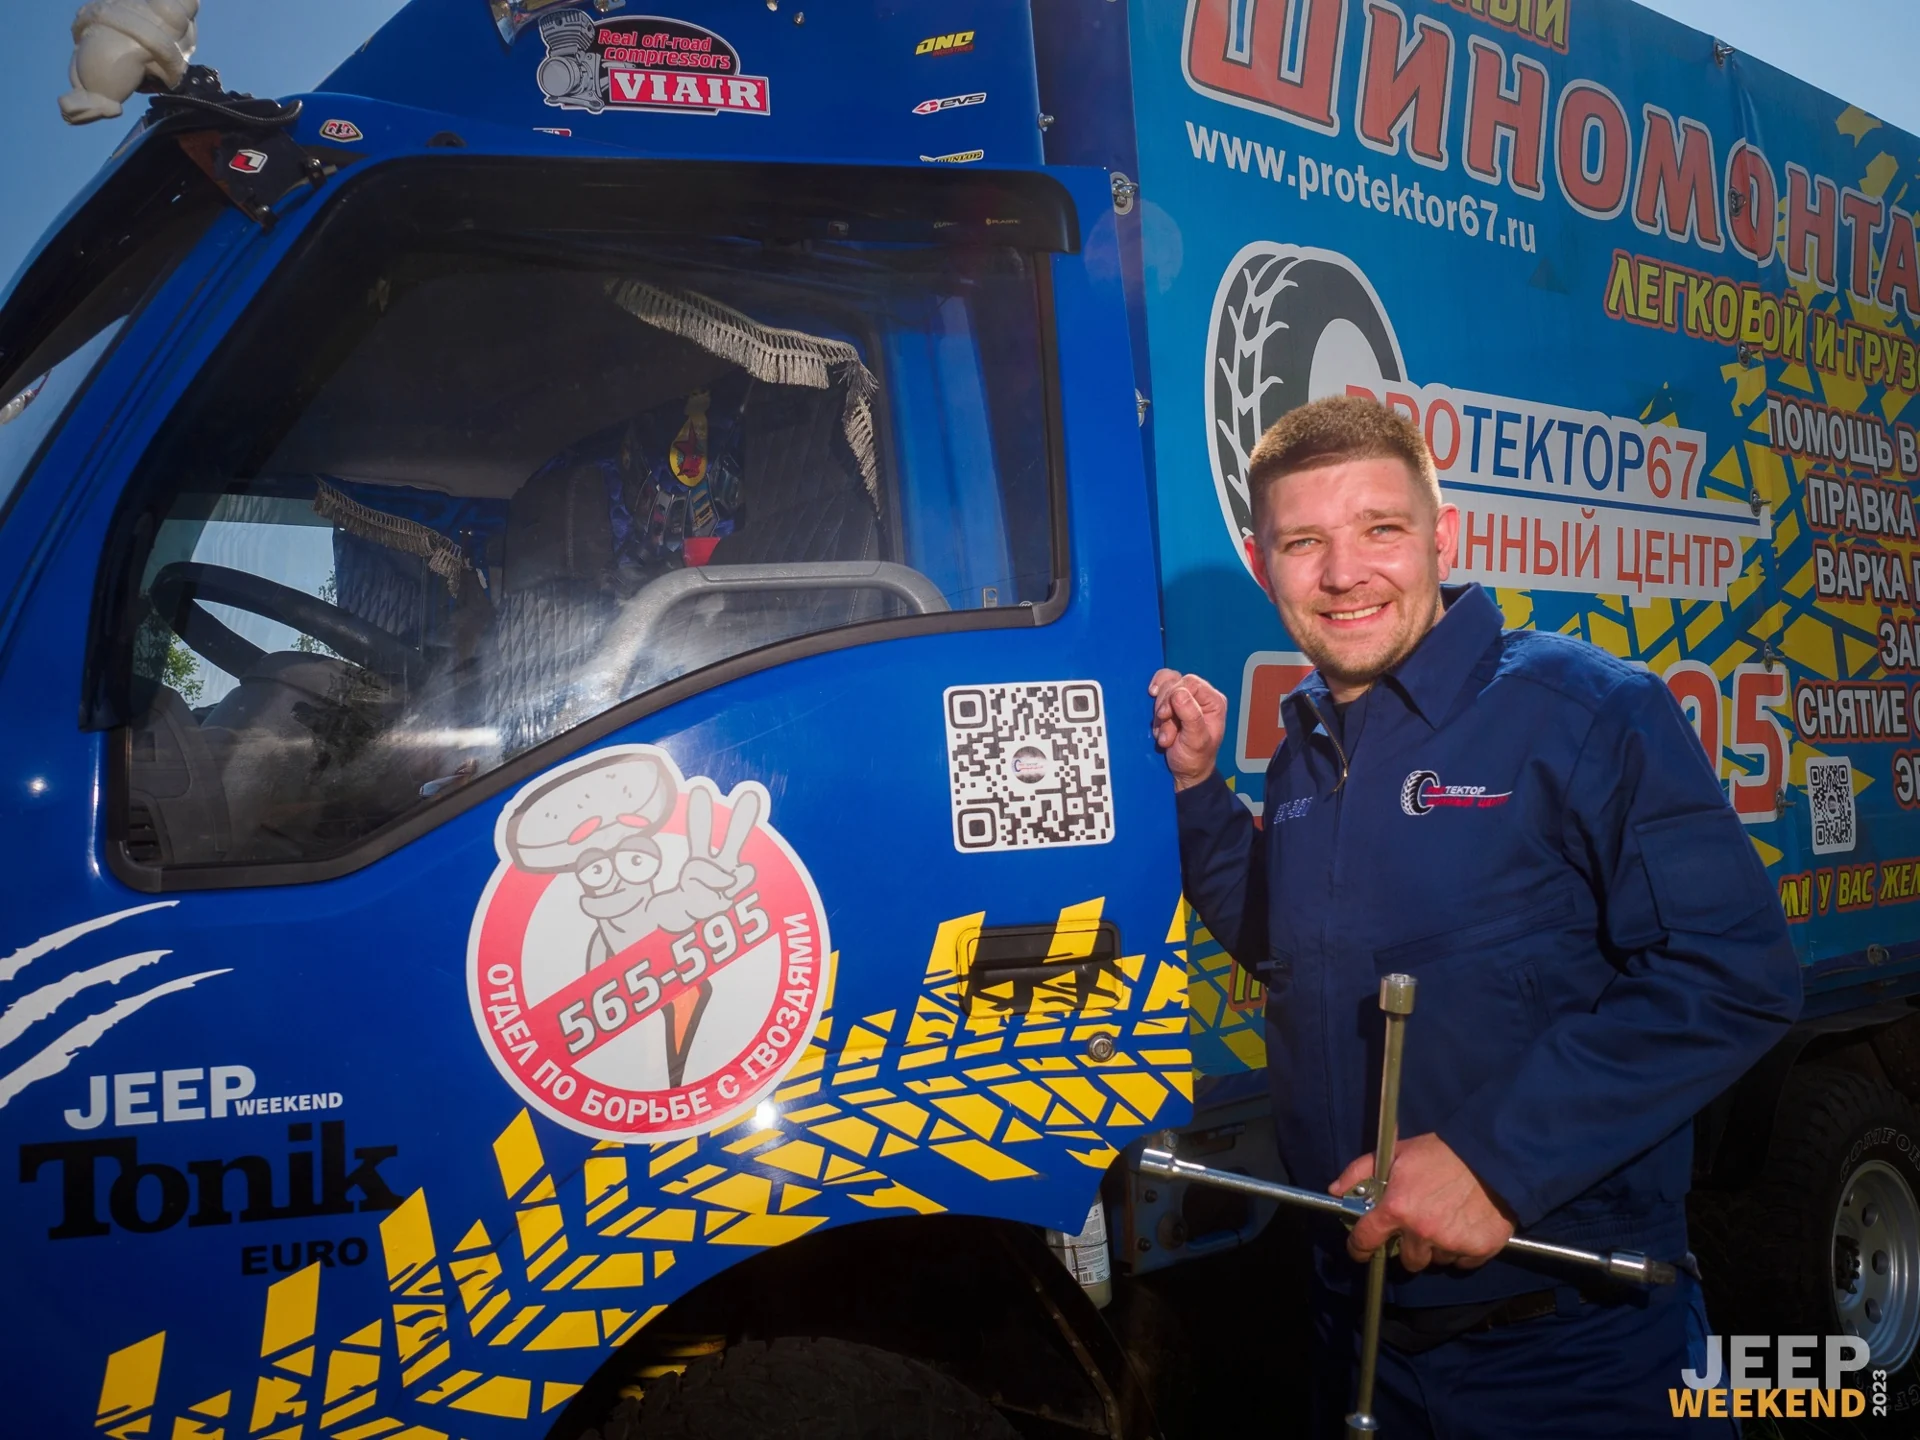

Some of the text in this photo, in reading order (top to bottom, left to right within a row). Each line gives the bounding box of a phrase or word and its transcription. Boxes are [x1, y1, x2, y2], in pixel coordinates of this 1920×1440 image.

[597, 28, 713, 52] Real off-road
[604, 46, 731, 69] compressors
[614, 71, 761, 109] VIAIR
[1184, 120, 1537, 254] www.protektor67.ru
[1607, 254, 1920, 391] ЛЕГКОВОЙ И ГРУЗ
[1766, 397, 1919, 476] ПОМОЩЬ В
[1807, 476, 1917, 539] ПРАВКА
[1451, 507, 1736, 594] ННЫЙ ЦЕНТР
[1815, 547, 1910, 602] ВАРКА
[1796, 686, 1908, 739] СНЯТИЕ
[1817, 872, 1834, 911] У
[1837, 867, 1876, 907] ВАС
[557, 892, 771, 1056] 565-595
[486, 912, 814, 1125] ОТДЕЛ ПО БОРЬБЕ С ГВОЗДЯМИ
[63, 1064, 344, 1130] JEEP WEEKEND
[18, 1120, 406, 1240] Tonik
[241, 1236, 369, 1276] EURO
